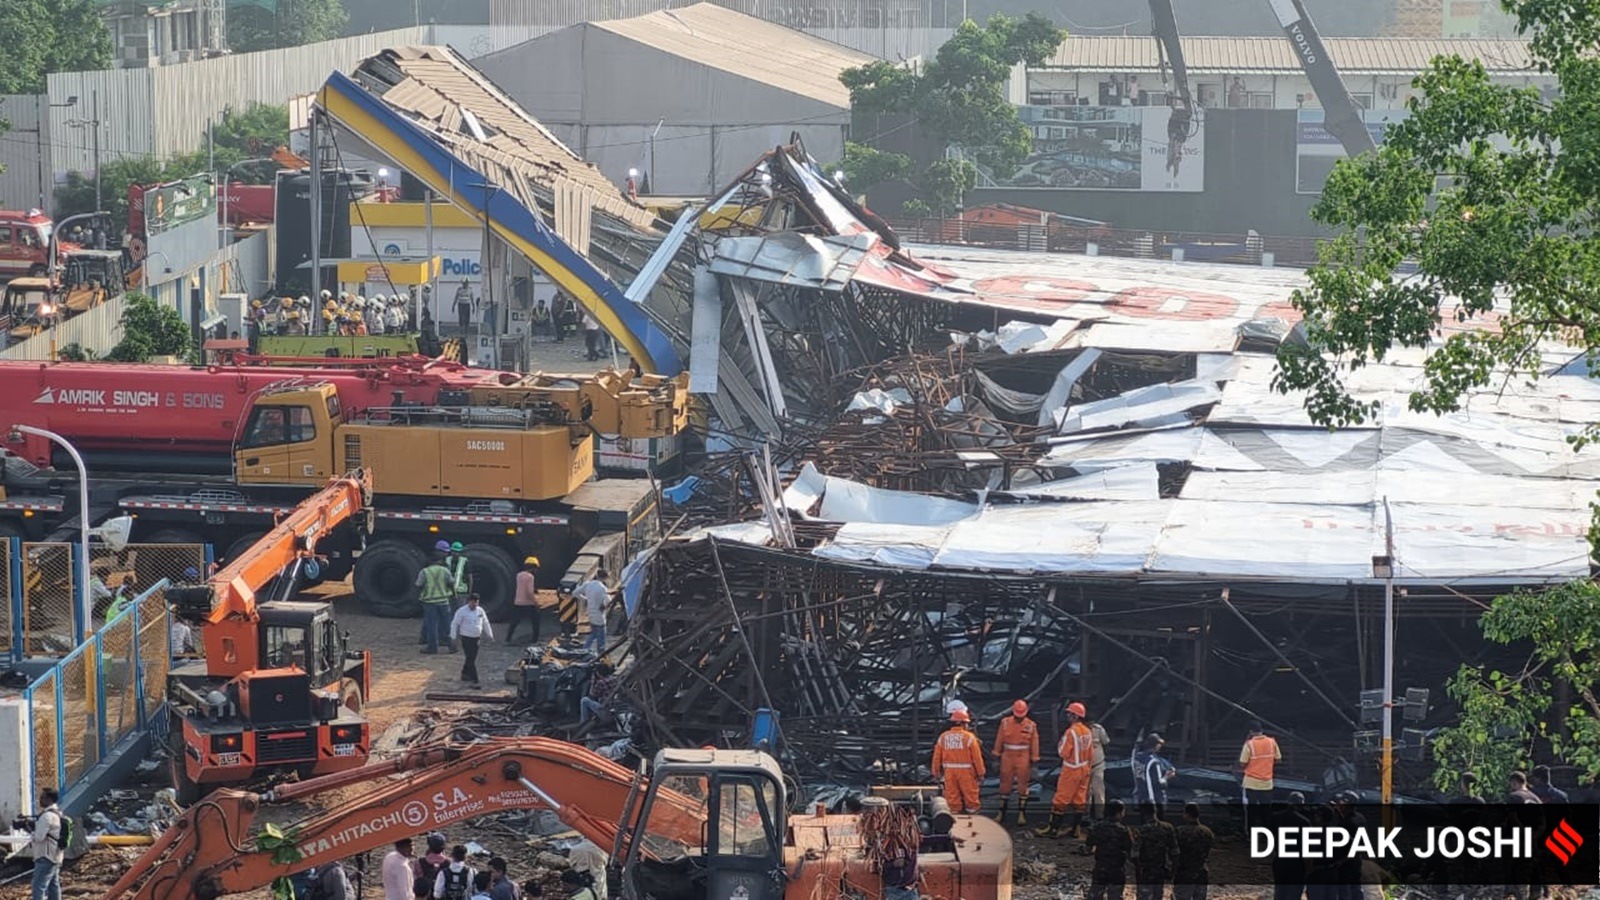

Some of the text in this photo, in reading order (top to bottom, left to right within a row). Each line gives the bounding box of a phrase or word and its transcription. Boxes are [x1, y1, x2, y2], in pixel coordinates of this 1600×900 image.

[1292, 25, 1316, 64] VOLVO
[1149, 147, 1166, 155] THE
[442, 258, 481, 275] Polic
[58, 389, 106, 405] AMRIK
[113, 390, 159, 407] SINGH
[183, 393, 224, 409] SONS
[432, 786, 473, 811] S.A.
[433, 799, 484, 823] Enterprises
[297, 811, 402, 858] TA HITACHI
